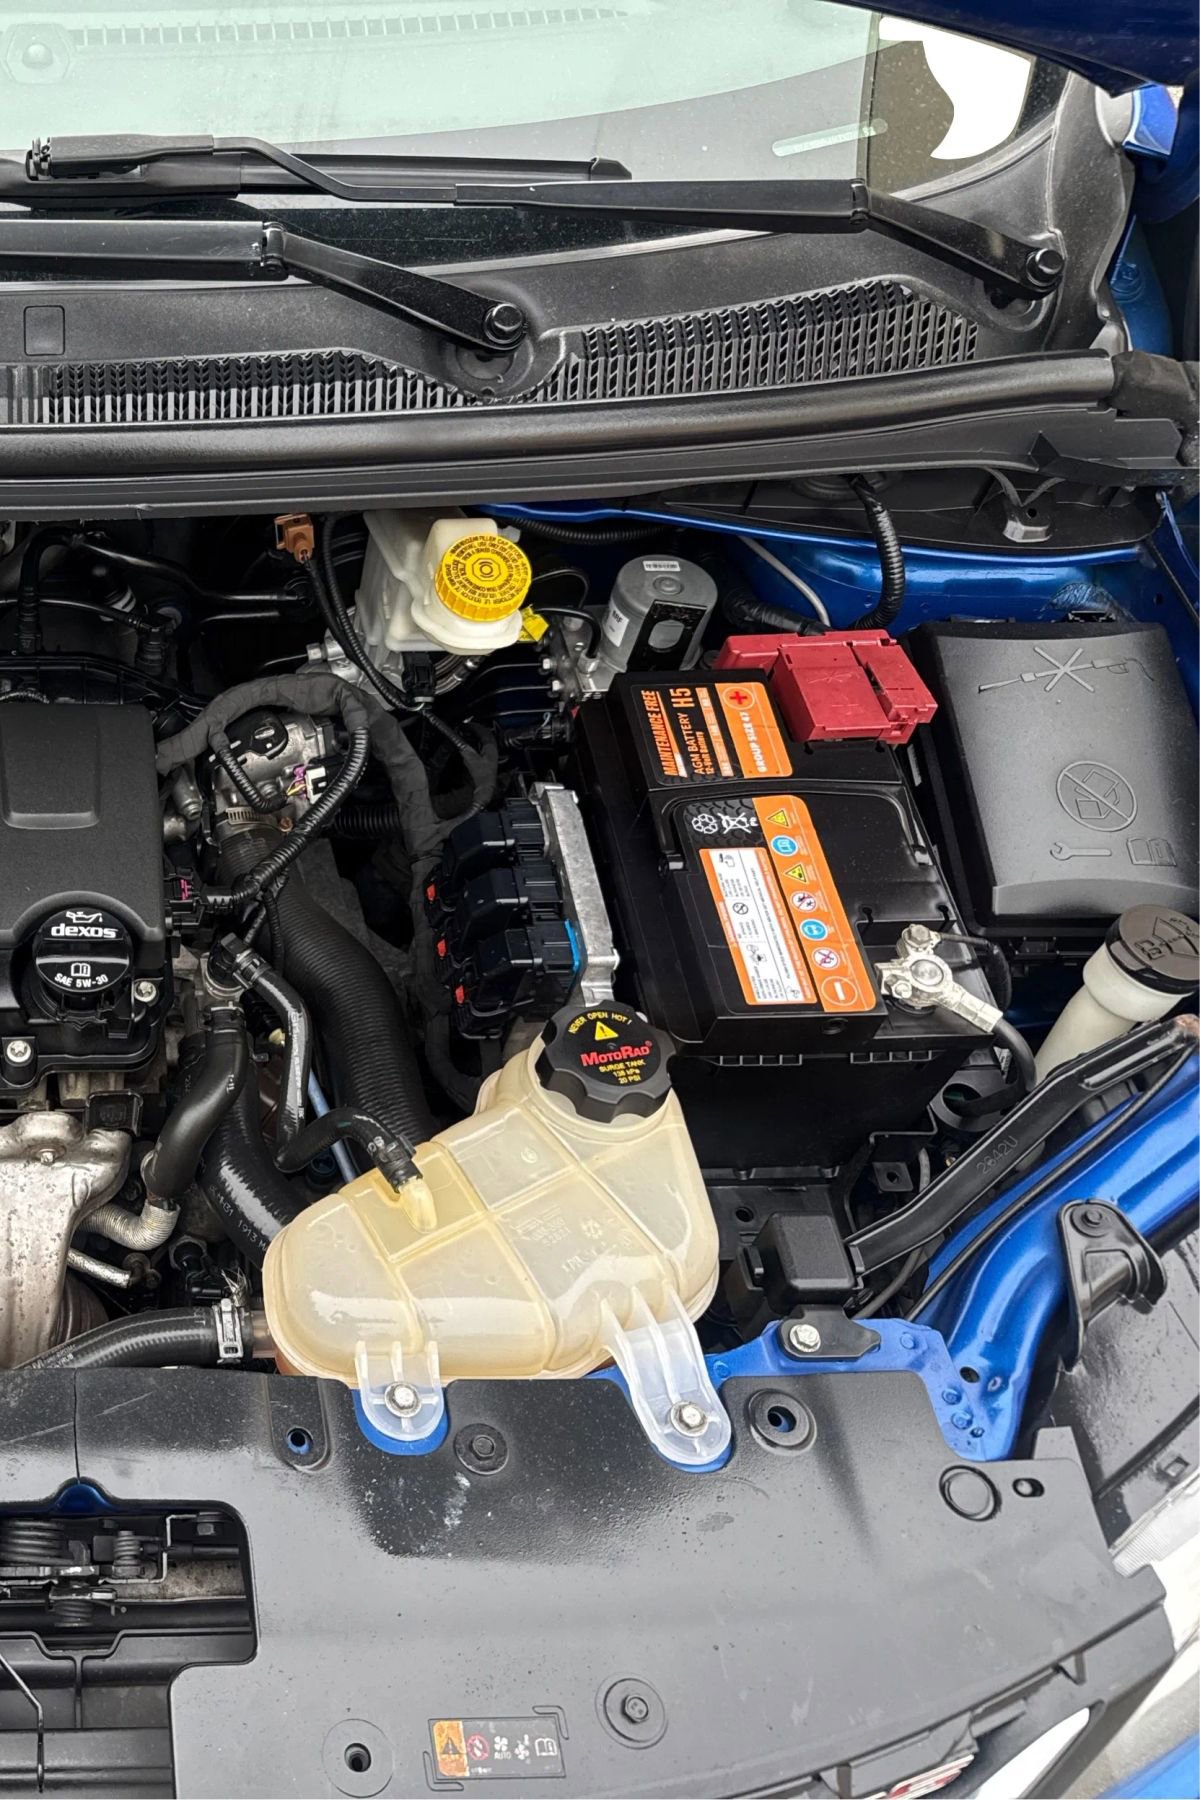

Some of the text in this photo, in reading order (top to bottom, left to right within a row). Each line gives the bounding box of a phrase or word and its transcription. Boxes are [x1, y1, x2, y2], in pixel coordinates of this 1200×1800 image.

[669, 687, 695, 708] H5
[641, 690, 679, 776] MAINTENANCE FREE
[677, 713, 698, 753] BATTERY
[742, 722, 758, 742] SIZE
[690, 753, 705, 775] AGM
[749, 742, 768, 774] GROUP
[51, 923, 119, 938] dexos
[54, 972, 109, 988] SAE 5W-30
[568, 1016, 587, 1034] NEVER
[587, 1011, 608, 1020] OPEN
[598, 1062, 625, 1072] SURGE
[618, 1075, 641, 1085] 20 PSI
